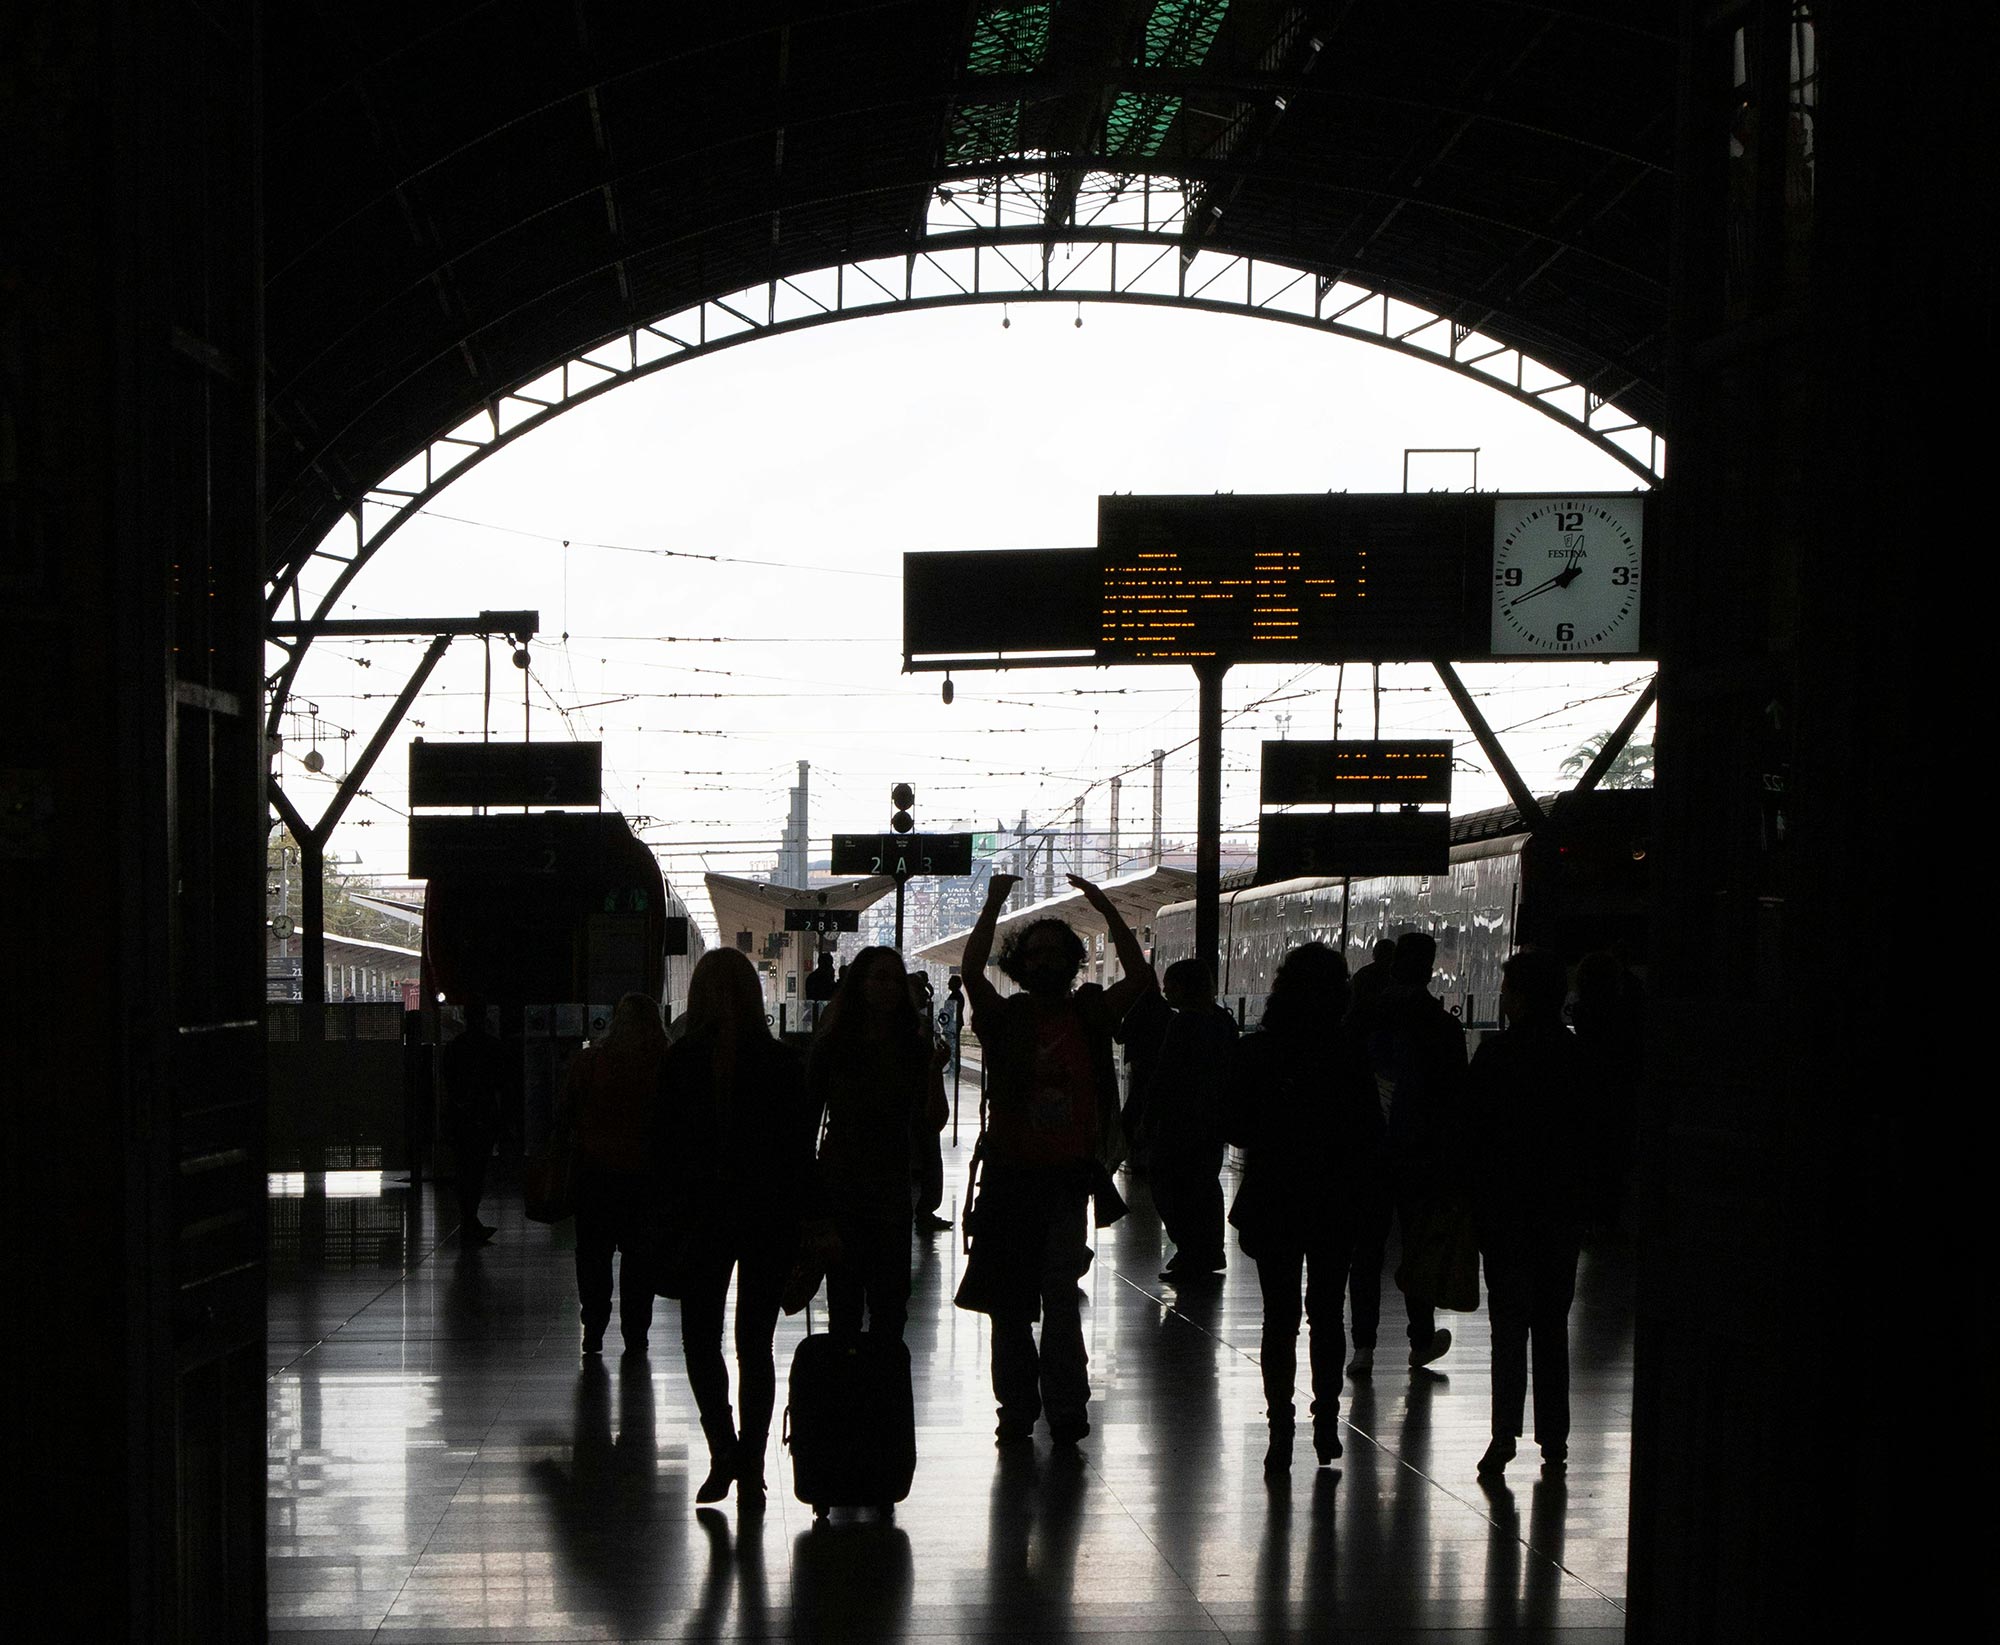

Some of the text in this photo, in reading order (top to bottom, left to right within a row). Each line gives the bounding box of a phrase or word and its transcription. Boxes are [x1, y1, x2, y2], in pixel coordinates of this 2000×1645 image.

[1555, 513, 1583, 531] 12
[1505, 568, 1522, 586] 9
[1612, 567, 1629, 585] 3
[1557, 623, 1574, 641] 6
[544, 775, 558, 801] 2
[543, 847, 557, 874] 2
[870, 856, 933, 874] 2 A 3
[292, 968, 302, 977] 21
[292, 991, 302, 1000] 21
